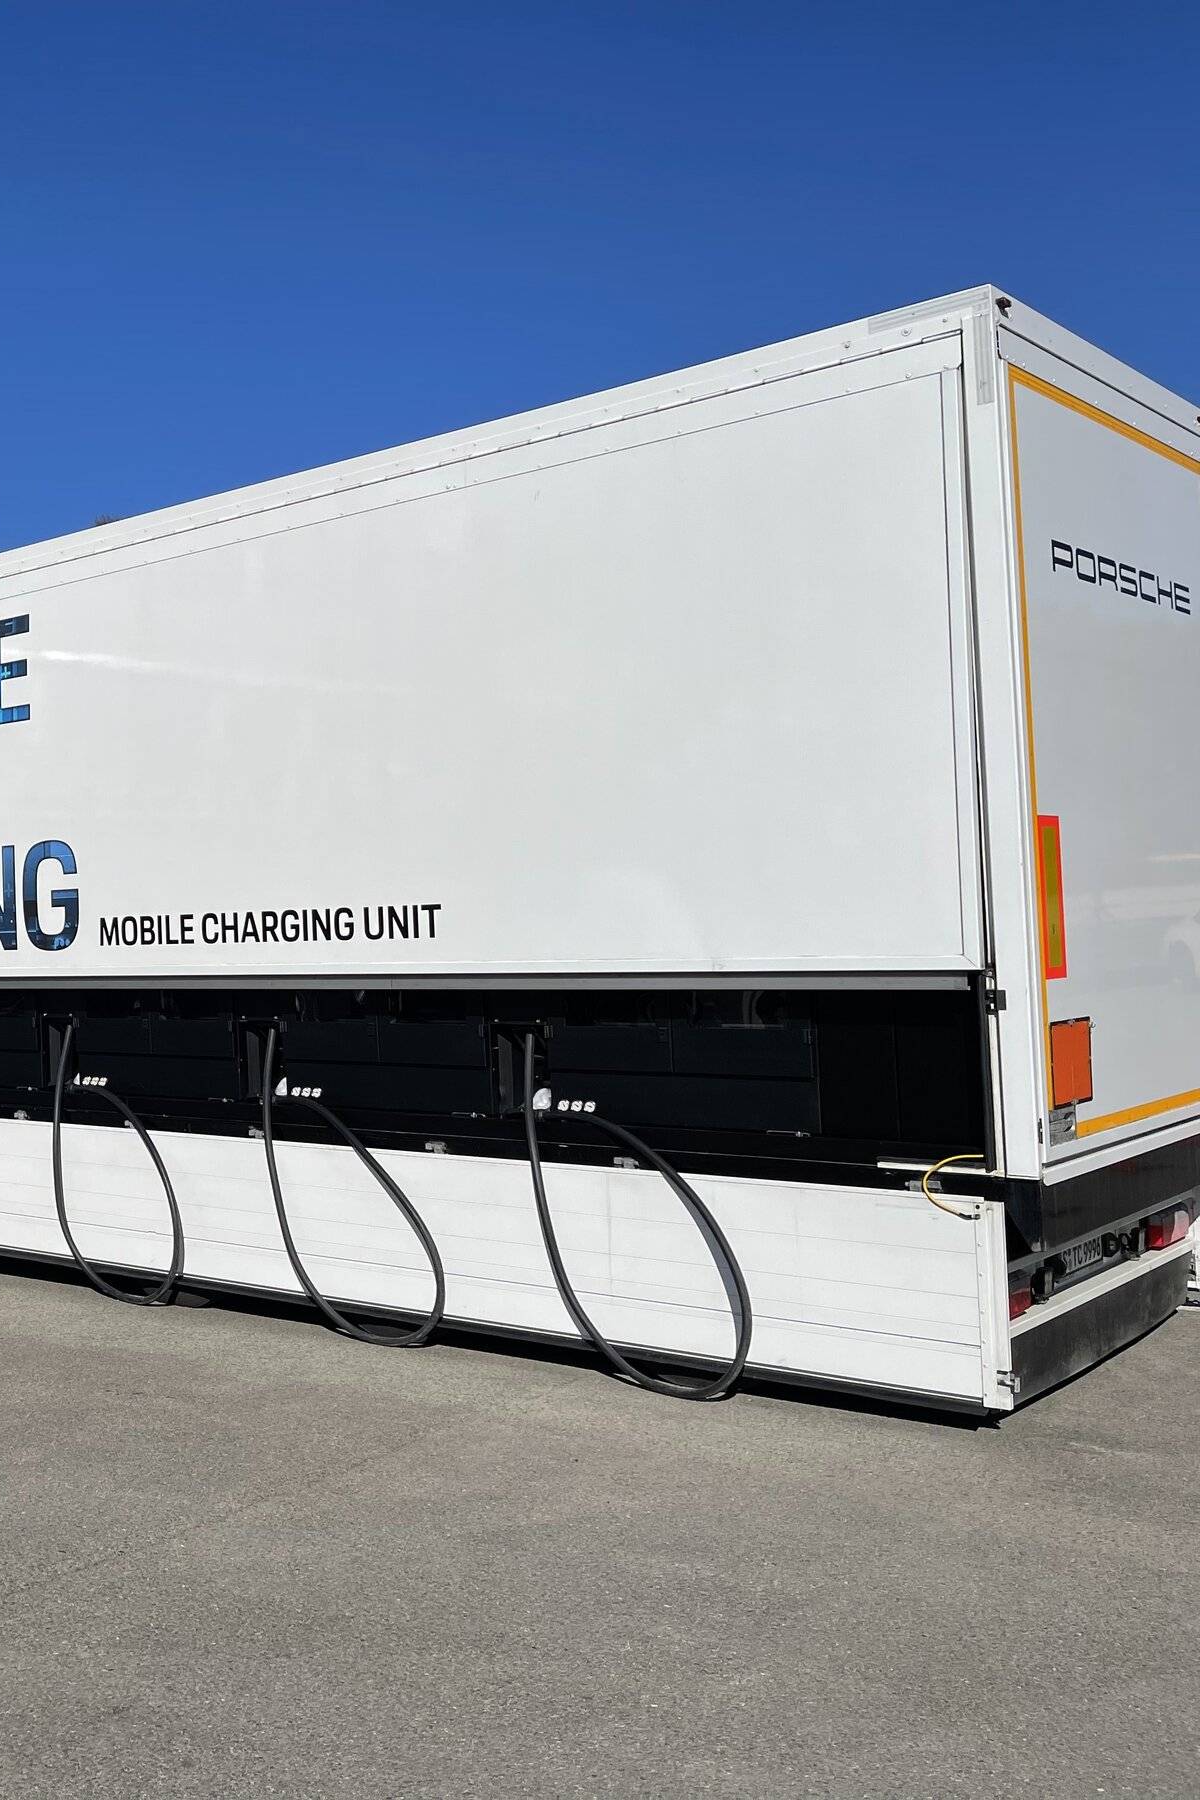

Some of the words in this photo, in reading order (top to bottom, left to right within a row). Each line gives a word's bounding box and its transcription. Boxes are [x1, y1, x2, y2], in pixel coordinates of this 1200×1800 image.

[1051, 539, 1191, 615] PORSCHE
[99, 914, 195, 946] MOBILE
[202, 907, 354, 944] CHARGING
[364, 904, 442, 940] UNIT
